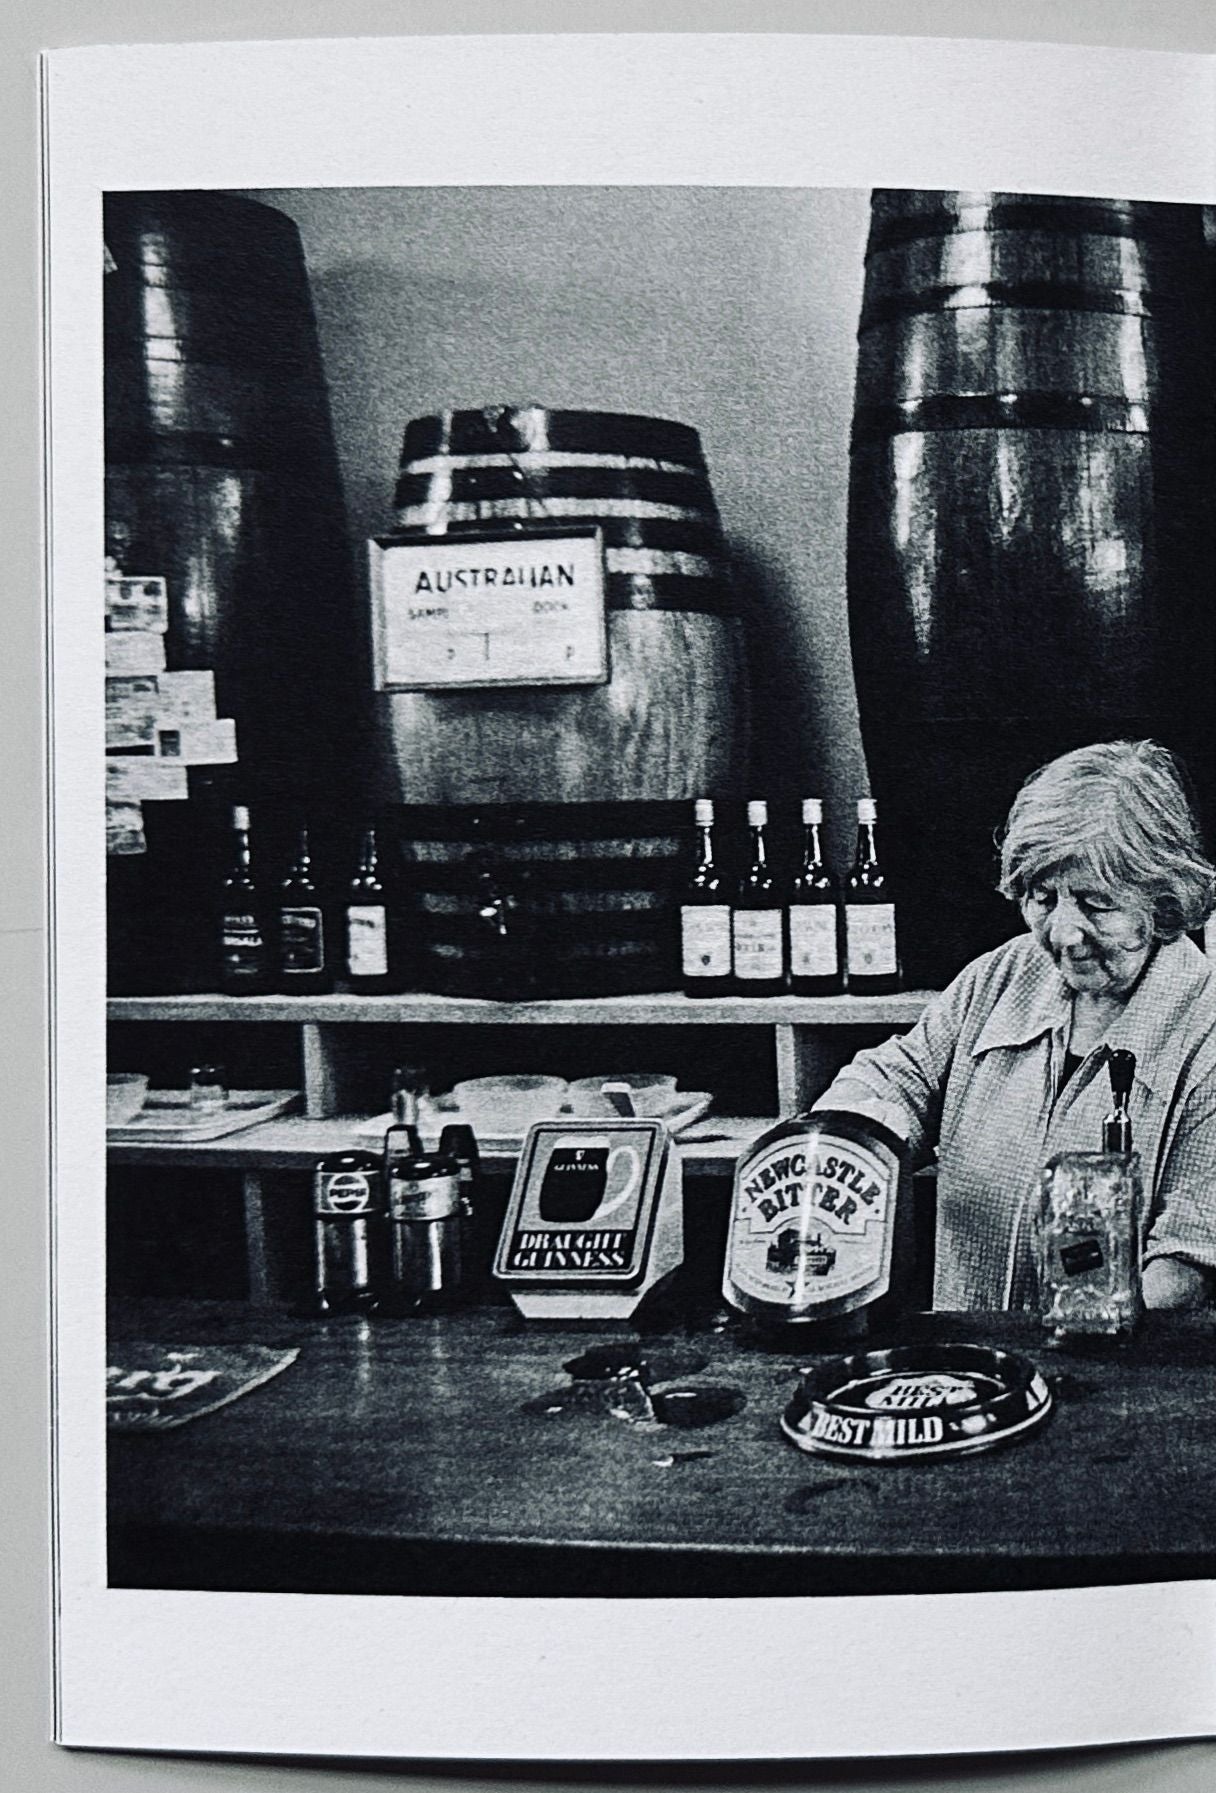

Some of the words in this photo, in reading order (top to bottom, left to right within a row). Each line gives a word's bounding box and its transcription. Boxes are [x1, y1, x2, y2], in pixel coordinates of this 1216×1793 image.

[513, 1251, 625, 1267] GUINNESS
[812, 1412, 871, 1444] BEST
[869, 1416, 944, 1448] MILD
